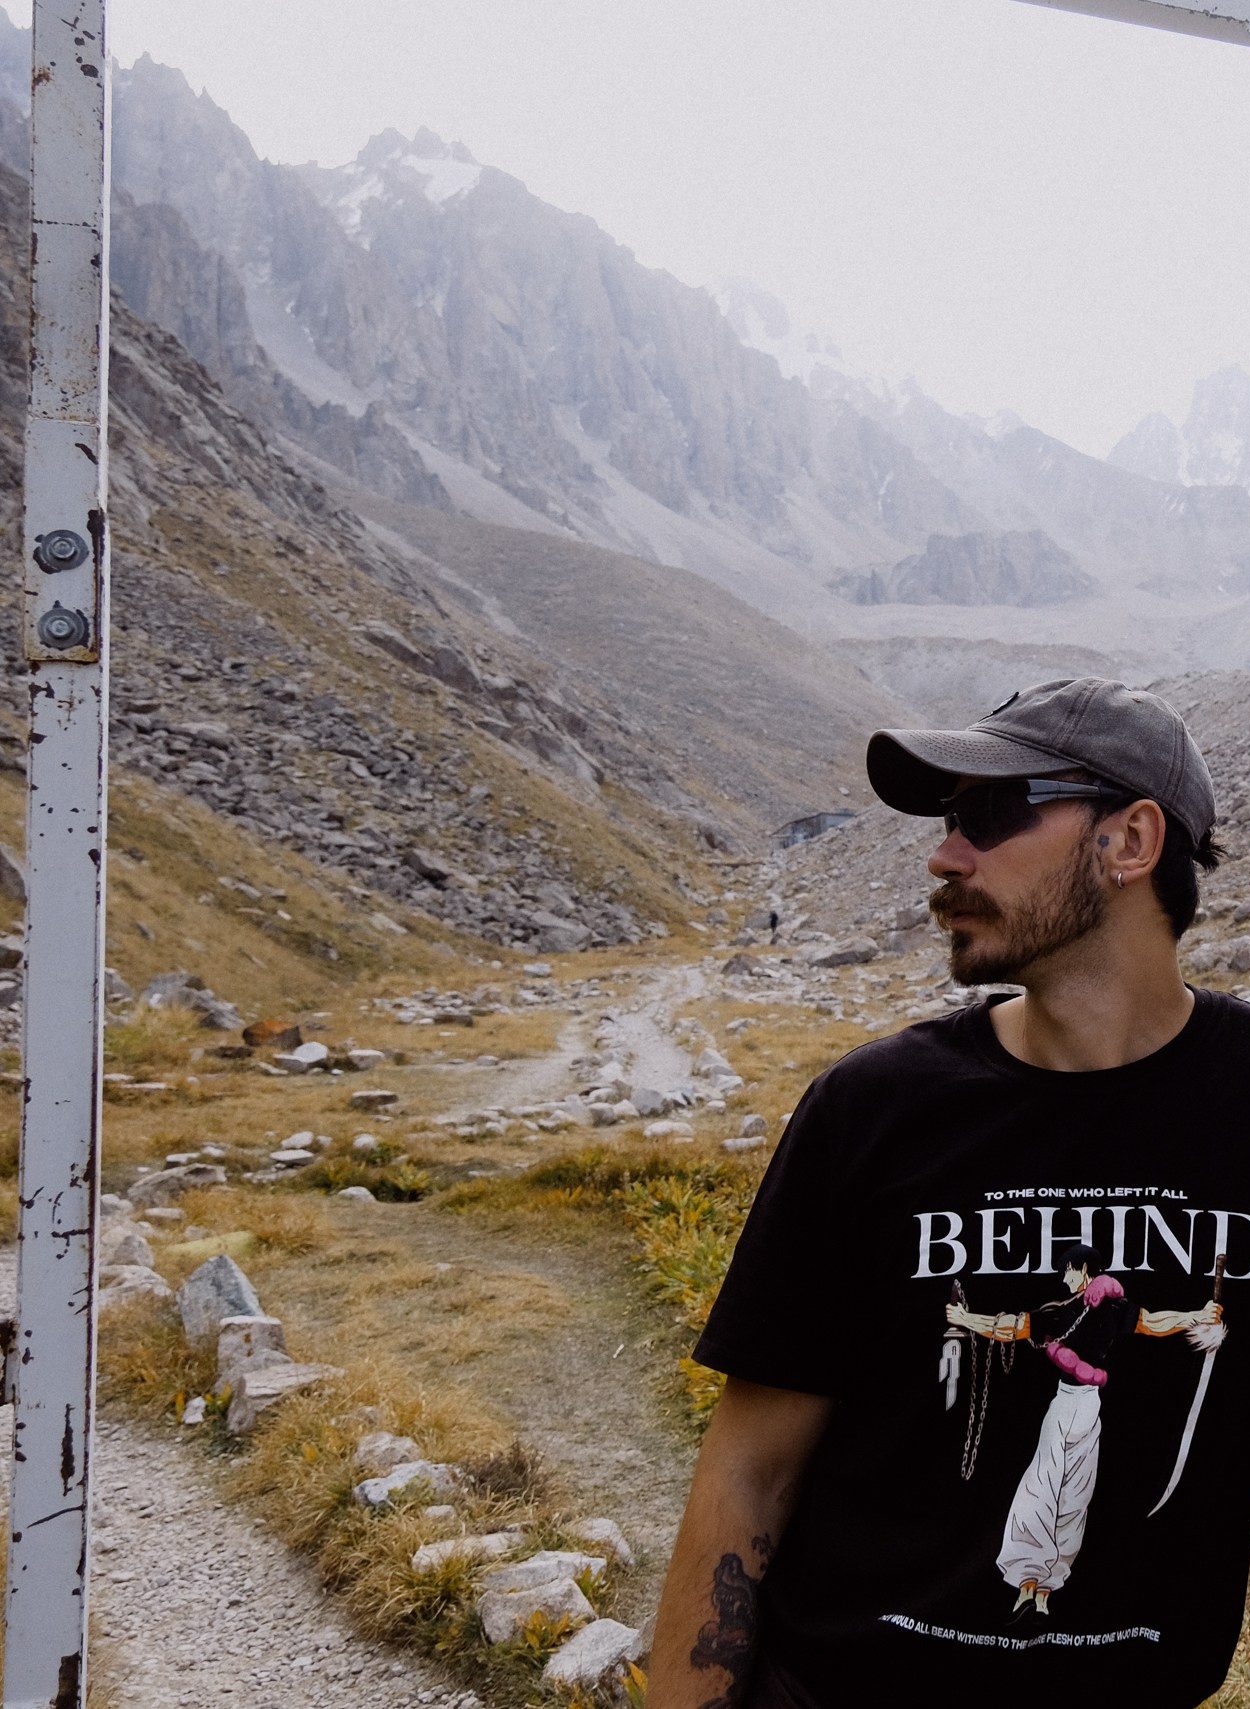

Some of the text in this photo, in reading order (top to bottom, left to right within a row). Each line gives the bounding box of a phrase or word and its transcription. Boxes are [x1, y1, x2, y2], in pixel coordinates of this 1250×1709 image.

[985, 1187, 1188, 1201] TO THE ONE WHO LEFT IT ALL
[891, 1614, 915, 1630] WOULD
[914, 1621, 930, 1635] ALL
[931, 1626, 956, 1640] BEAR
[957, 1631, 996, 1646] WITNESS
[998, 1636, 1009, 1648] TO
[1011, 1638, 1028, 1650] THE
[1046, 1632, 1073, 1646] FLESH
[1074, 1634, 1086, 1646] OF
[1086, 1634, 1101, 1646] THE
[1102, 1632, 1116, 1644] ONE
[1131, 1626, 1139, 1638] IS
[1139, 1626, 1160, 1642] FREE
